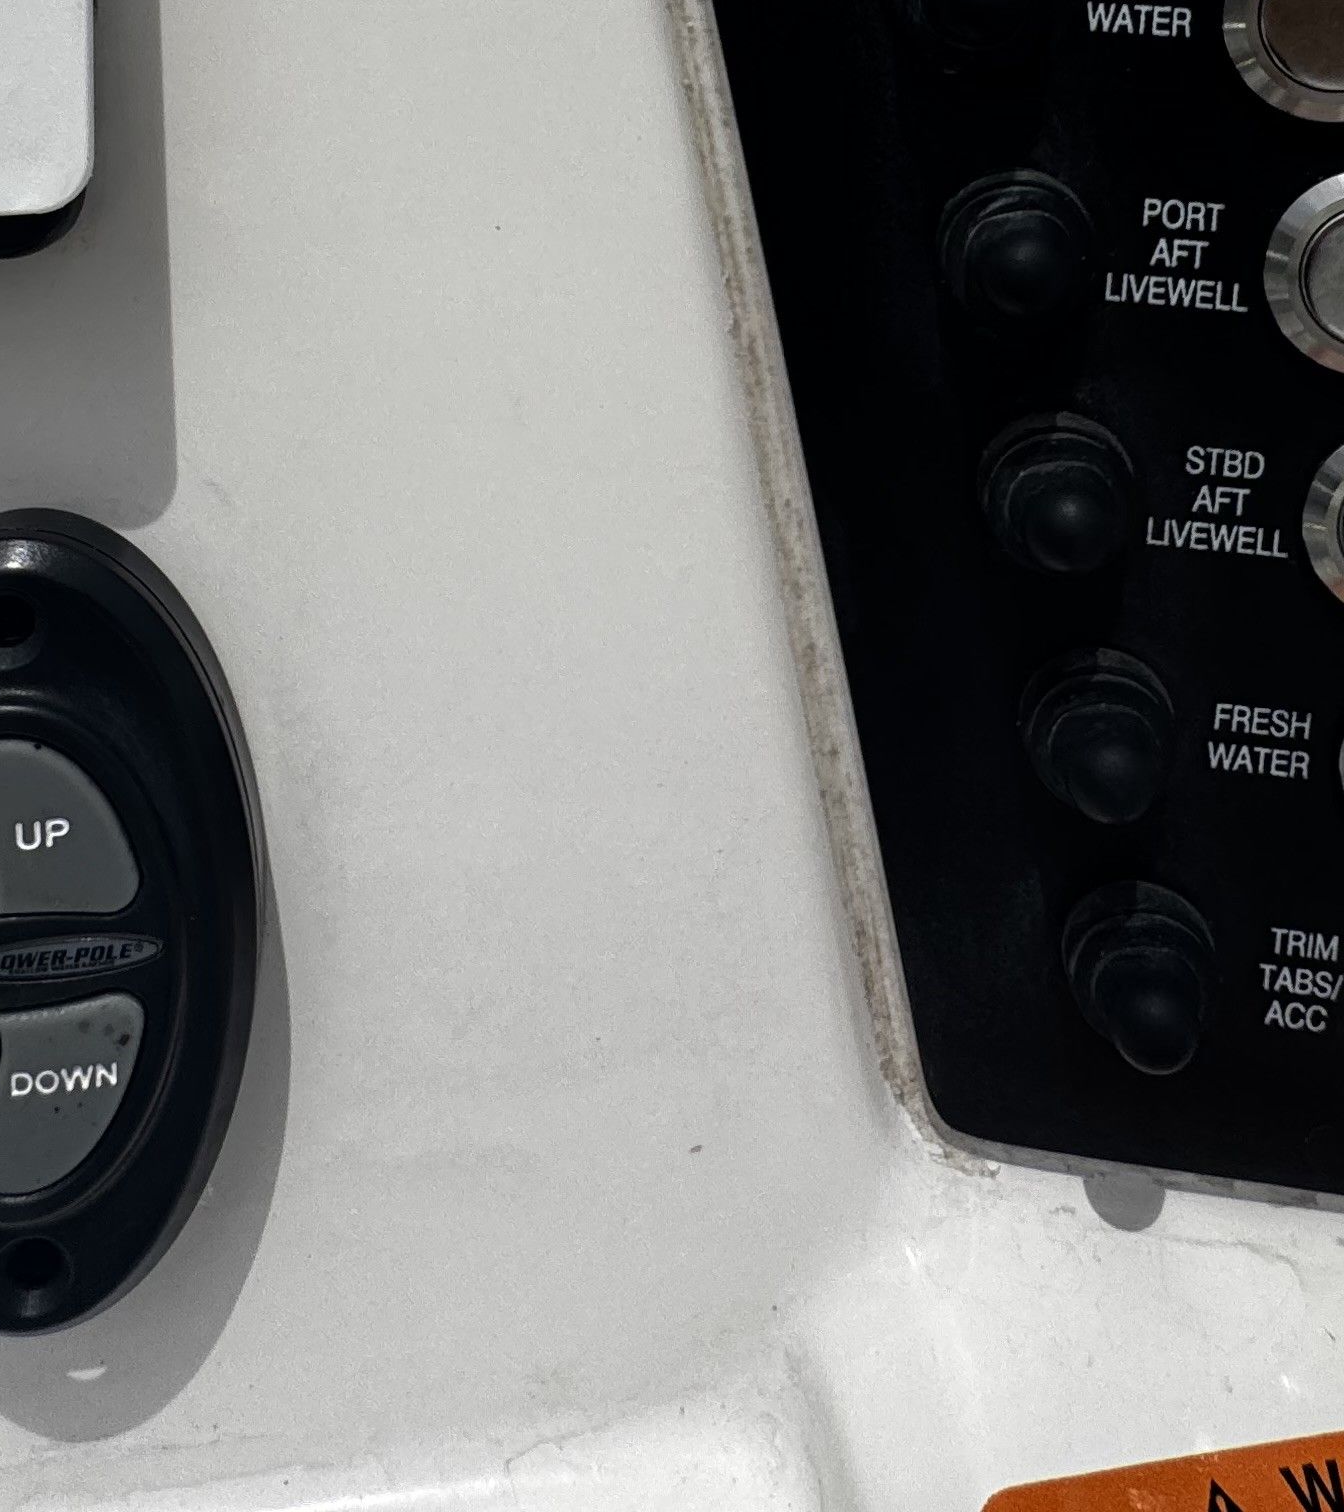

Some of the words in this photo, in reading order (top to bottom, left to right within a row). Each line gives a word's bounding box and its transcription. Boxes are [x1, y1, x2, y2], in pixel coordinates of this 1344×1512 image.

[1087, 2, 1192, 38] WATER
[1142, 197, 1225, 232] PORT
[1149, 238, 1209, 269] AFT
[1104, 272, 1249, 313] LIVEWELL
[1185, 445, 1265, 479] STBD
[1191, 484, 1251, 516] AFT
[1146, 517, 1289, 558] LIVEWELL
[1213, 703, 1312, 740] FRESH
[1208, 741, 1310, 779] WATER
[14, 817, 70, 851] UP
[1271, 927, 1340, 962] TRIM
[1259, 963, 1344, 1001] TABS/
[1263, 1000, 1329, 1033] ACC
[10, 1062, 119, 1097] DOWN
